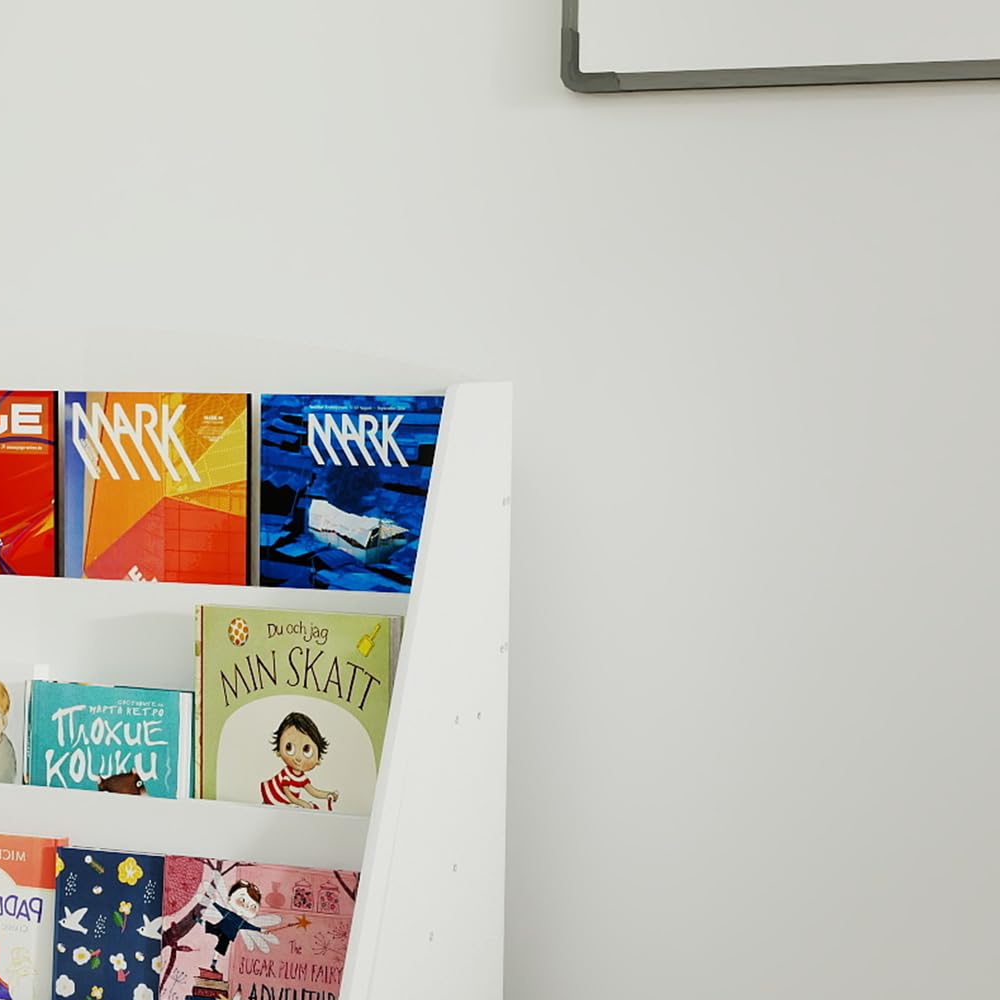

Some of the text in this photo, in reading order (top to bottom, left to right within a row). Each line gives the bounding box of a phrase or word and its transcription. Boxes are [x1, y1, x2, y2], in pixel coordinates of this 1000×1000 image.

[72, 402, 201, 483] MARK
[307, 413, 409, 467] MARK
[267, 620, 329, 646] Du och jag
[220, 646, 381, 711] MIN SKATT
[289, 940, 302, 954] The
[239, 957, 276, 979] SUGAR
[279, 961, 308, 980] PLUM
